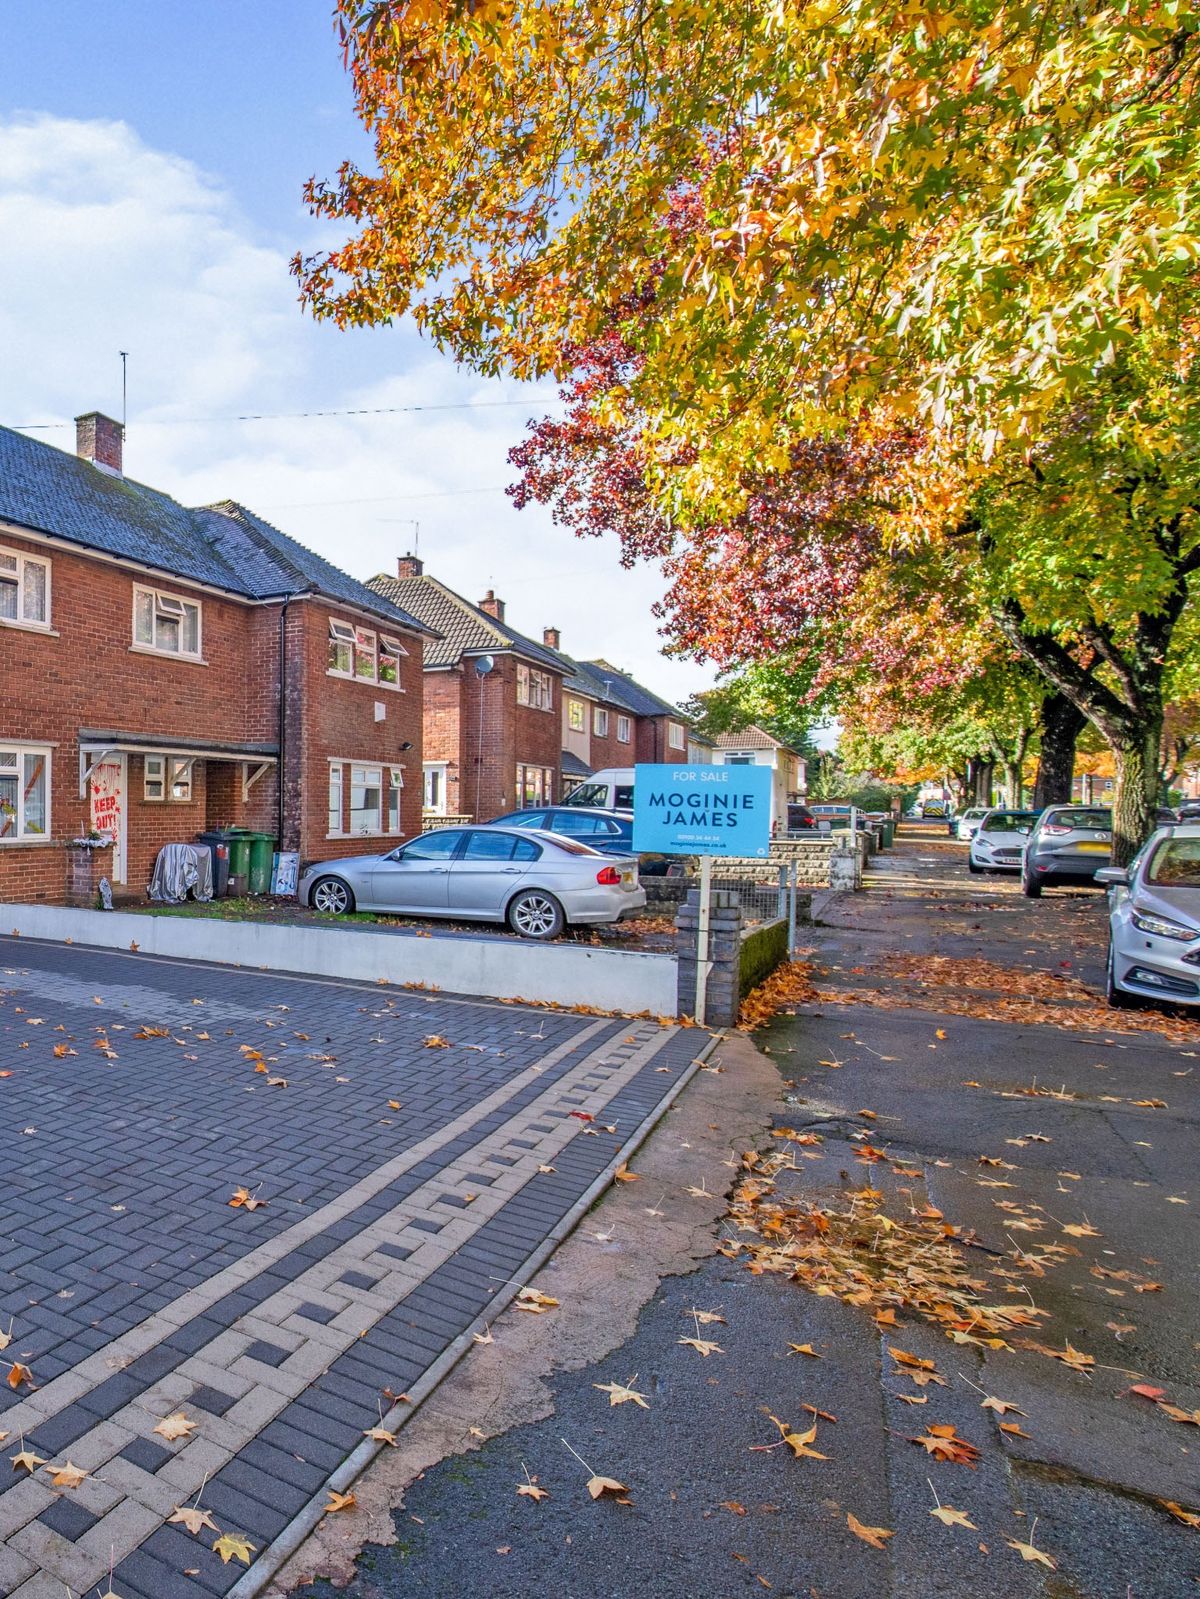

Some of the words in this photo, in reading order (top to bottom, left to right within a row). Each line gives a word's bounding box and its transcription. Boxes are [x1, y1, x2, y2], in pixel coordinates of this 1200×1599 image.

[672, 771, 697, 782] FOR
[700, 771, 729, 783] SALE
[94, 796, 116, 813] KEEP
[649, 792, 755, 810] MOGINIE
[662, 810, 738, 828] JAMES
